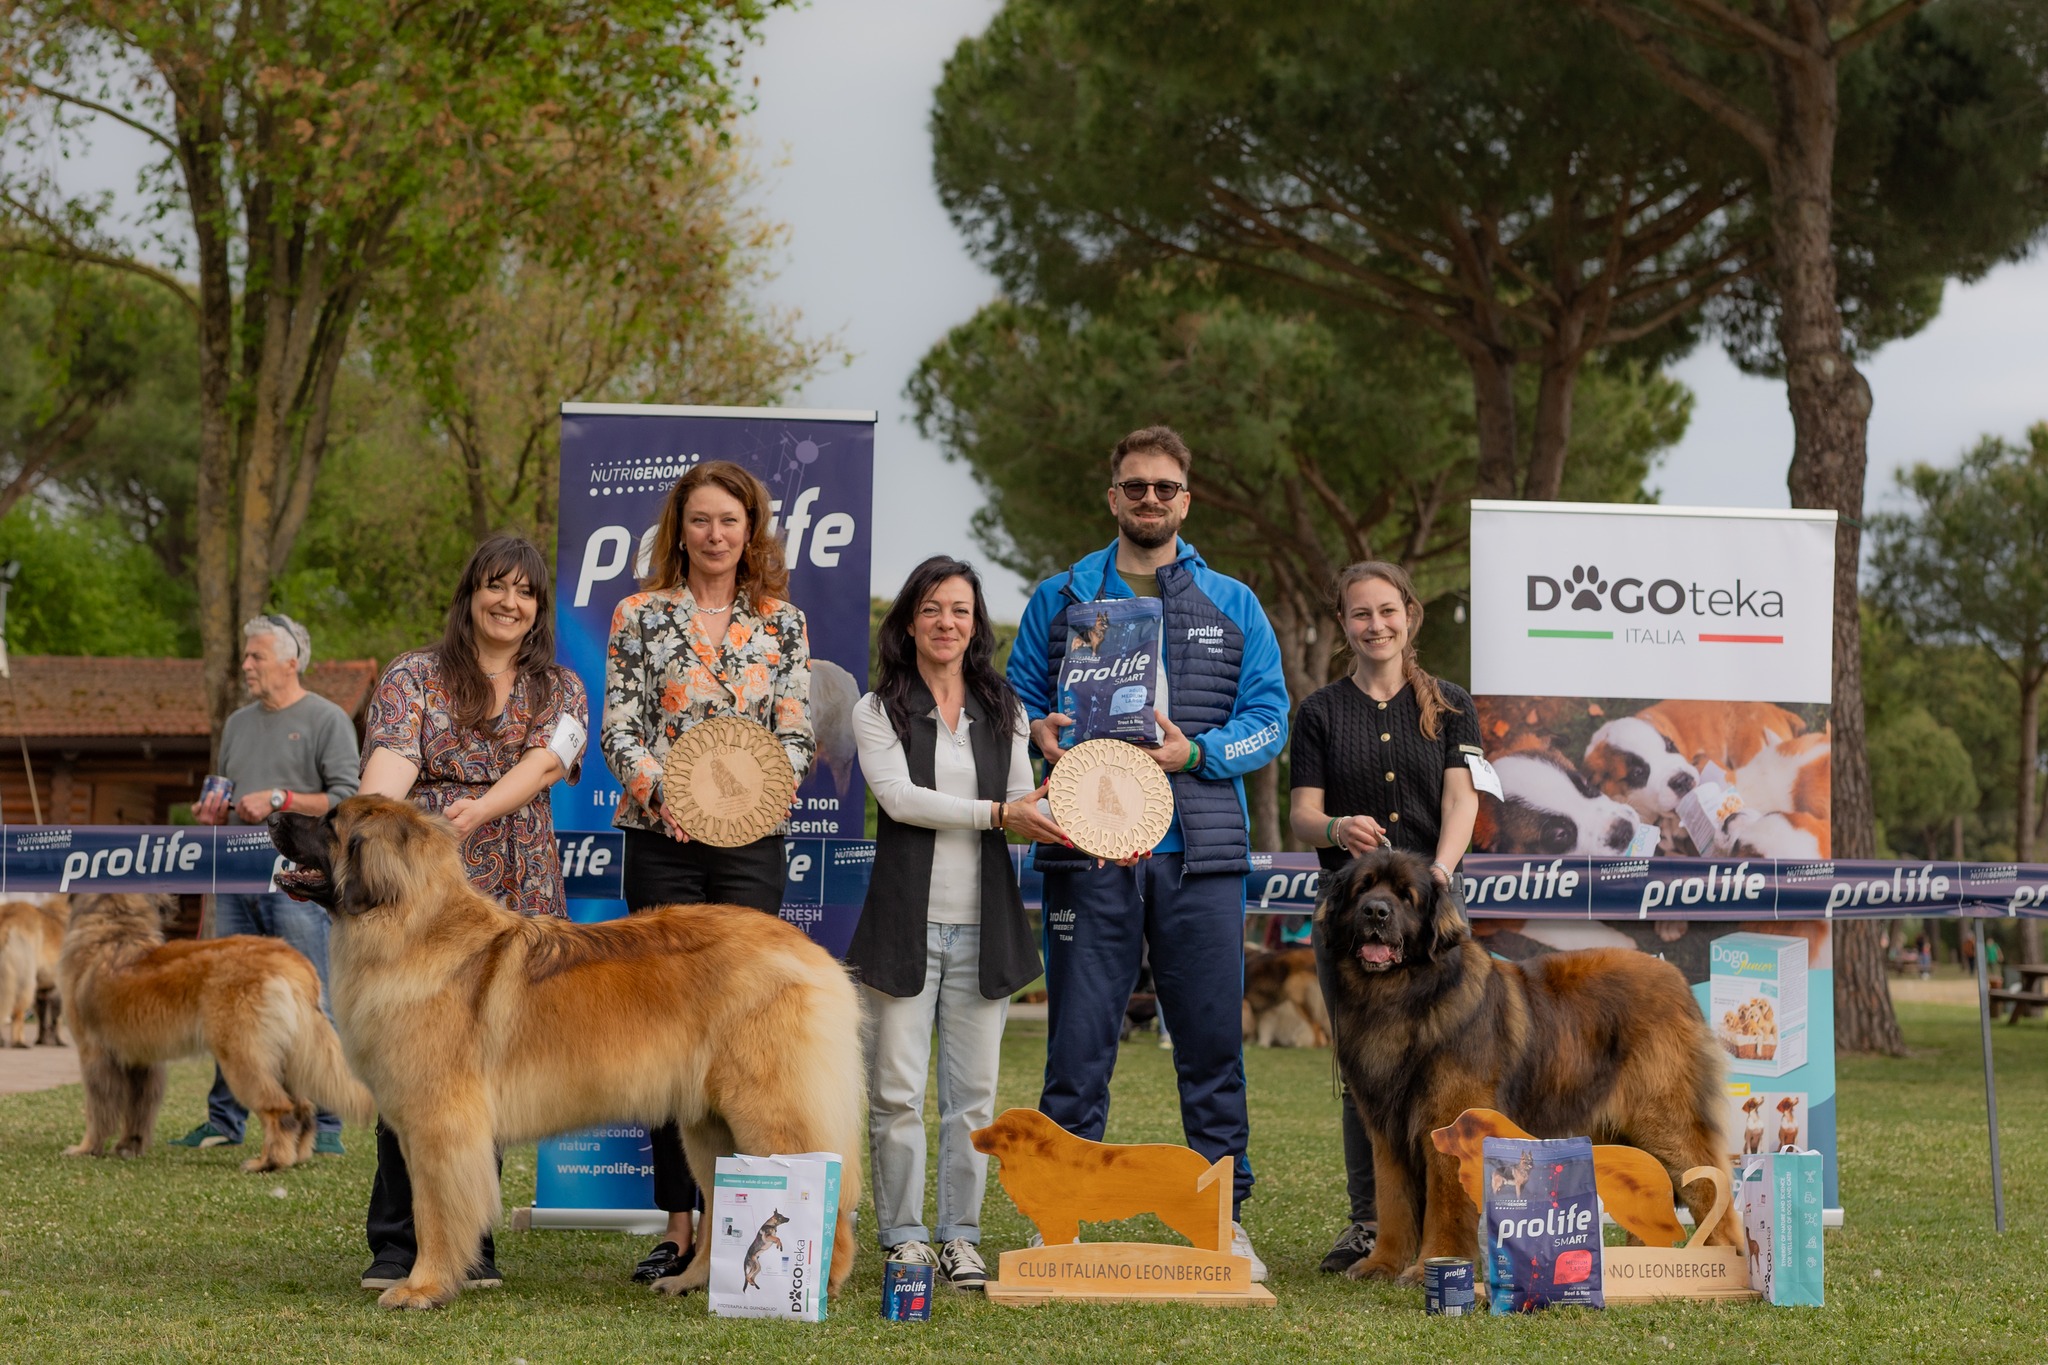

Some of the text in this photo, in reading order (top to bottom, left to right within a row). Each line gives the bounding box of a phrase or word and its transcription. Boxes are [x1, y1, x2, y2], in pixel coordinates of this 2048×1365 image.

[657, 480, 677, 492] SYS
[573, 486, 855, 608] prife
[1188, 625, 1224, 640] prolife
[1626, 628, 1686, 645] ITALIA
[1064, 651, 1151, 692] prolife
[1113, 673, 1145, 686] SMART
[568, 732, 579, 749] 45
[1224, 722, 1280, 760] BREEDER
[593, 790, 605, 806] il
[807, 797, 839, 811] non
[790, 819, 839, 833] sente
[17, 834, 73, 846] NUTRIGENOMIC
[227, 836, 273, 846] NUTRIGENO
[59, 829, 203, 893] prolife
[1639, 861, 1766, 919] prolife
[1825, 864, 1950, 918] prolife
[778, 909, 823, 921] FRESH
[1711, 944, 1749, 968] Dogo
[592, 1126, 645, 1138] secondo
[558, 1140, 601, 1151] natura
[557, 1162, 655, 1178] www.prolife-pe
[1197, 1155, 1234, 1253] 1
[1681, 1165, 1736, 1247] 2
[1496, 1203, 1592, 1249] prolife
[1554, 1234, 1588, 1247] SMART
[1018, 1261, 1232, 1282] CLUB ITALIANO LEONBERGER
[1444, 1267, 1467, 1280] prolife
[1638, 1263, 1727, 1279] LEONBERGER
[893, 1280, 927, 1295] prolife
